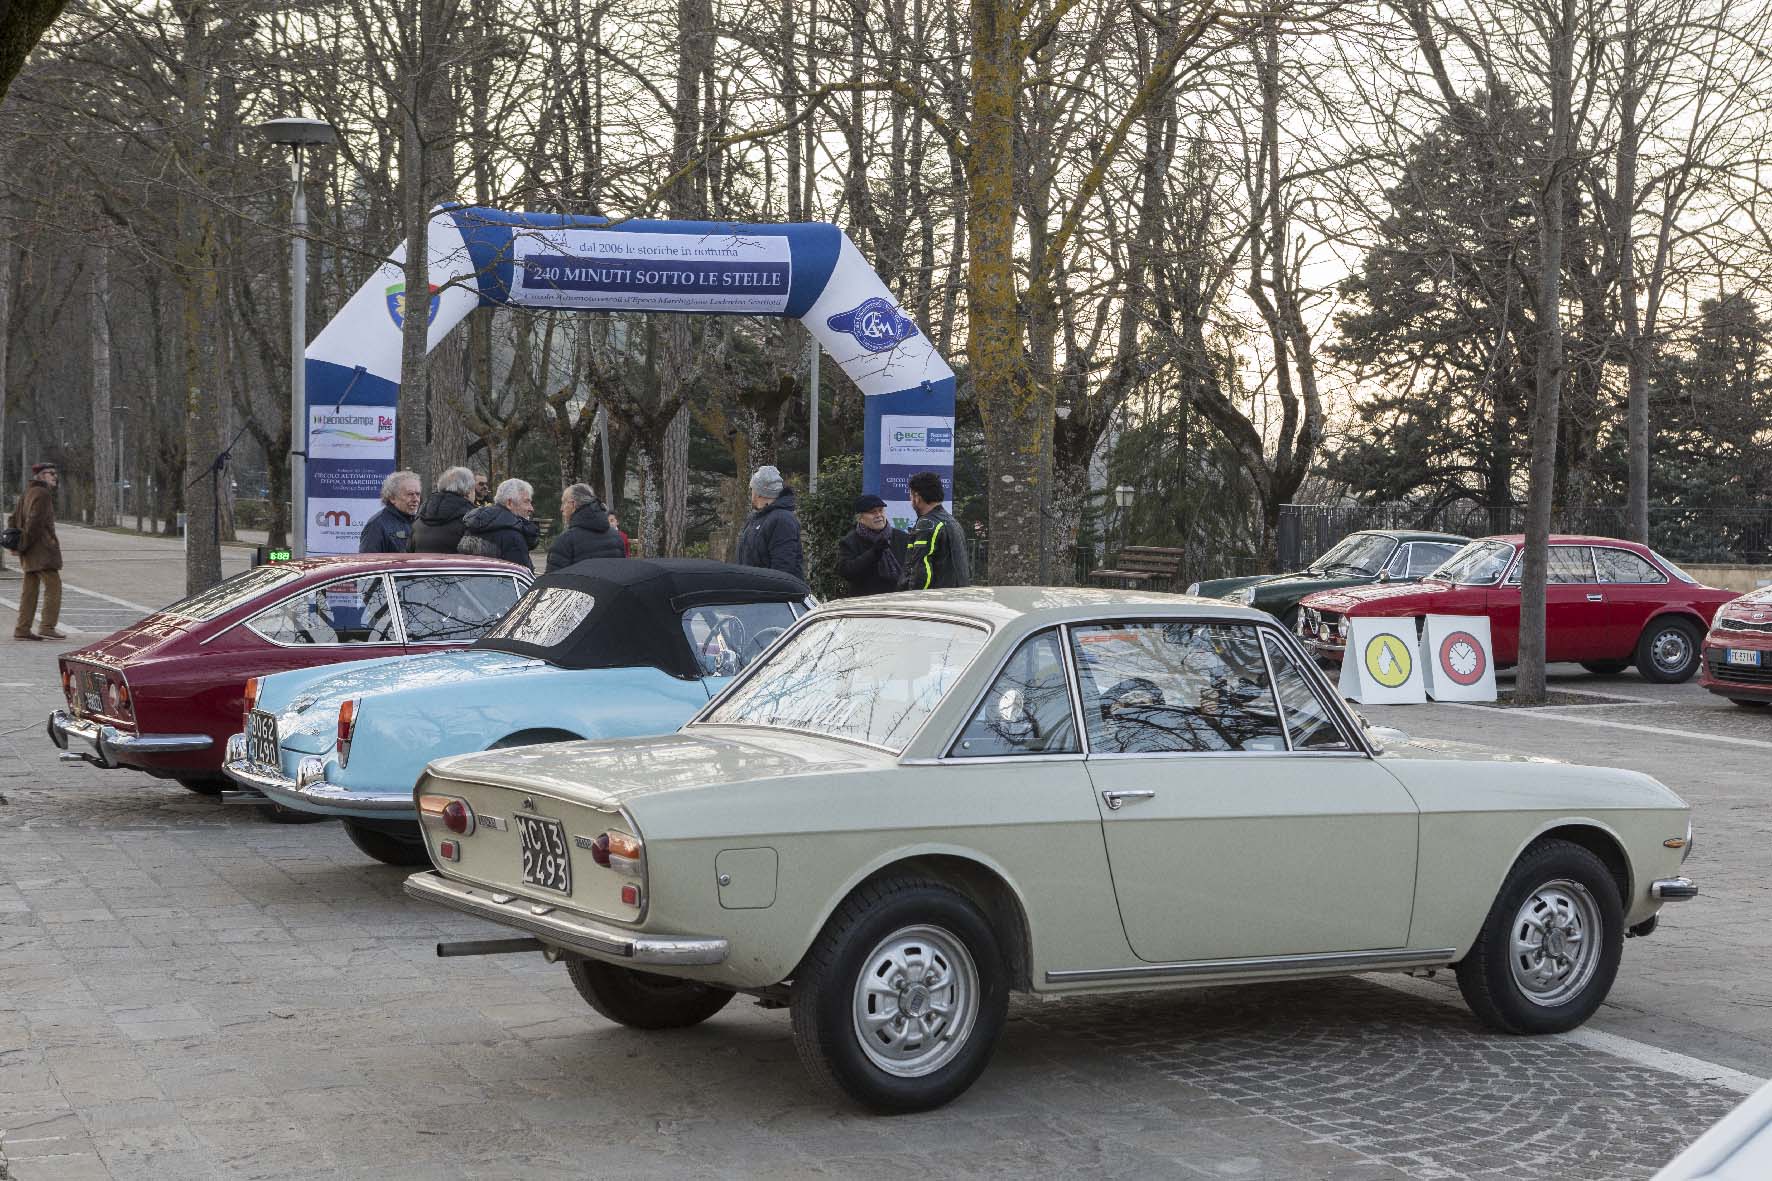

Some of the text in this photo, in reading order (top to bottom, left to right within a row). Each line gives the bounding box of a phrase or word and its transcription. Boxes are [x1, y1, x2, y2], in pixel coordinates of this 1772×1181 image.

[580, 242, 596, 253] dal
[599, 243, 623, 254] 2006
[638, 244, 679, 256] storiche
[681, 246, 692, 256] in
[694, 247, 739, 257] notturna
[533, 266, 781, 287] 240 MINUTI SOTTO LE STELLE
[904, 431, 925, 439] BCC
[515, 817, 562, 854] MC13
[523, 850, 567, 890] 2493
